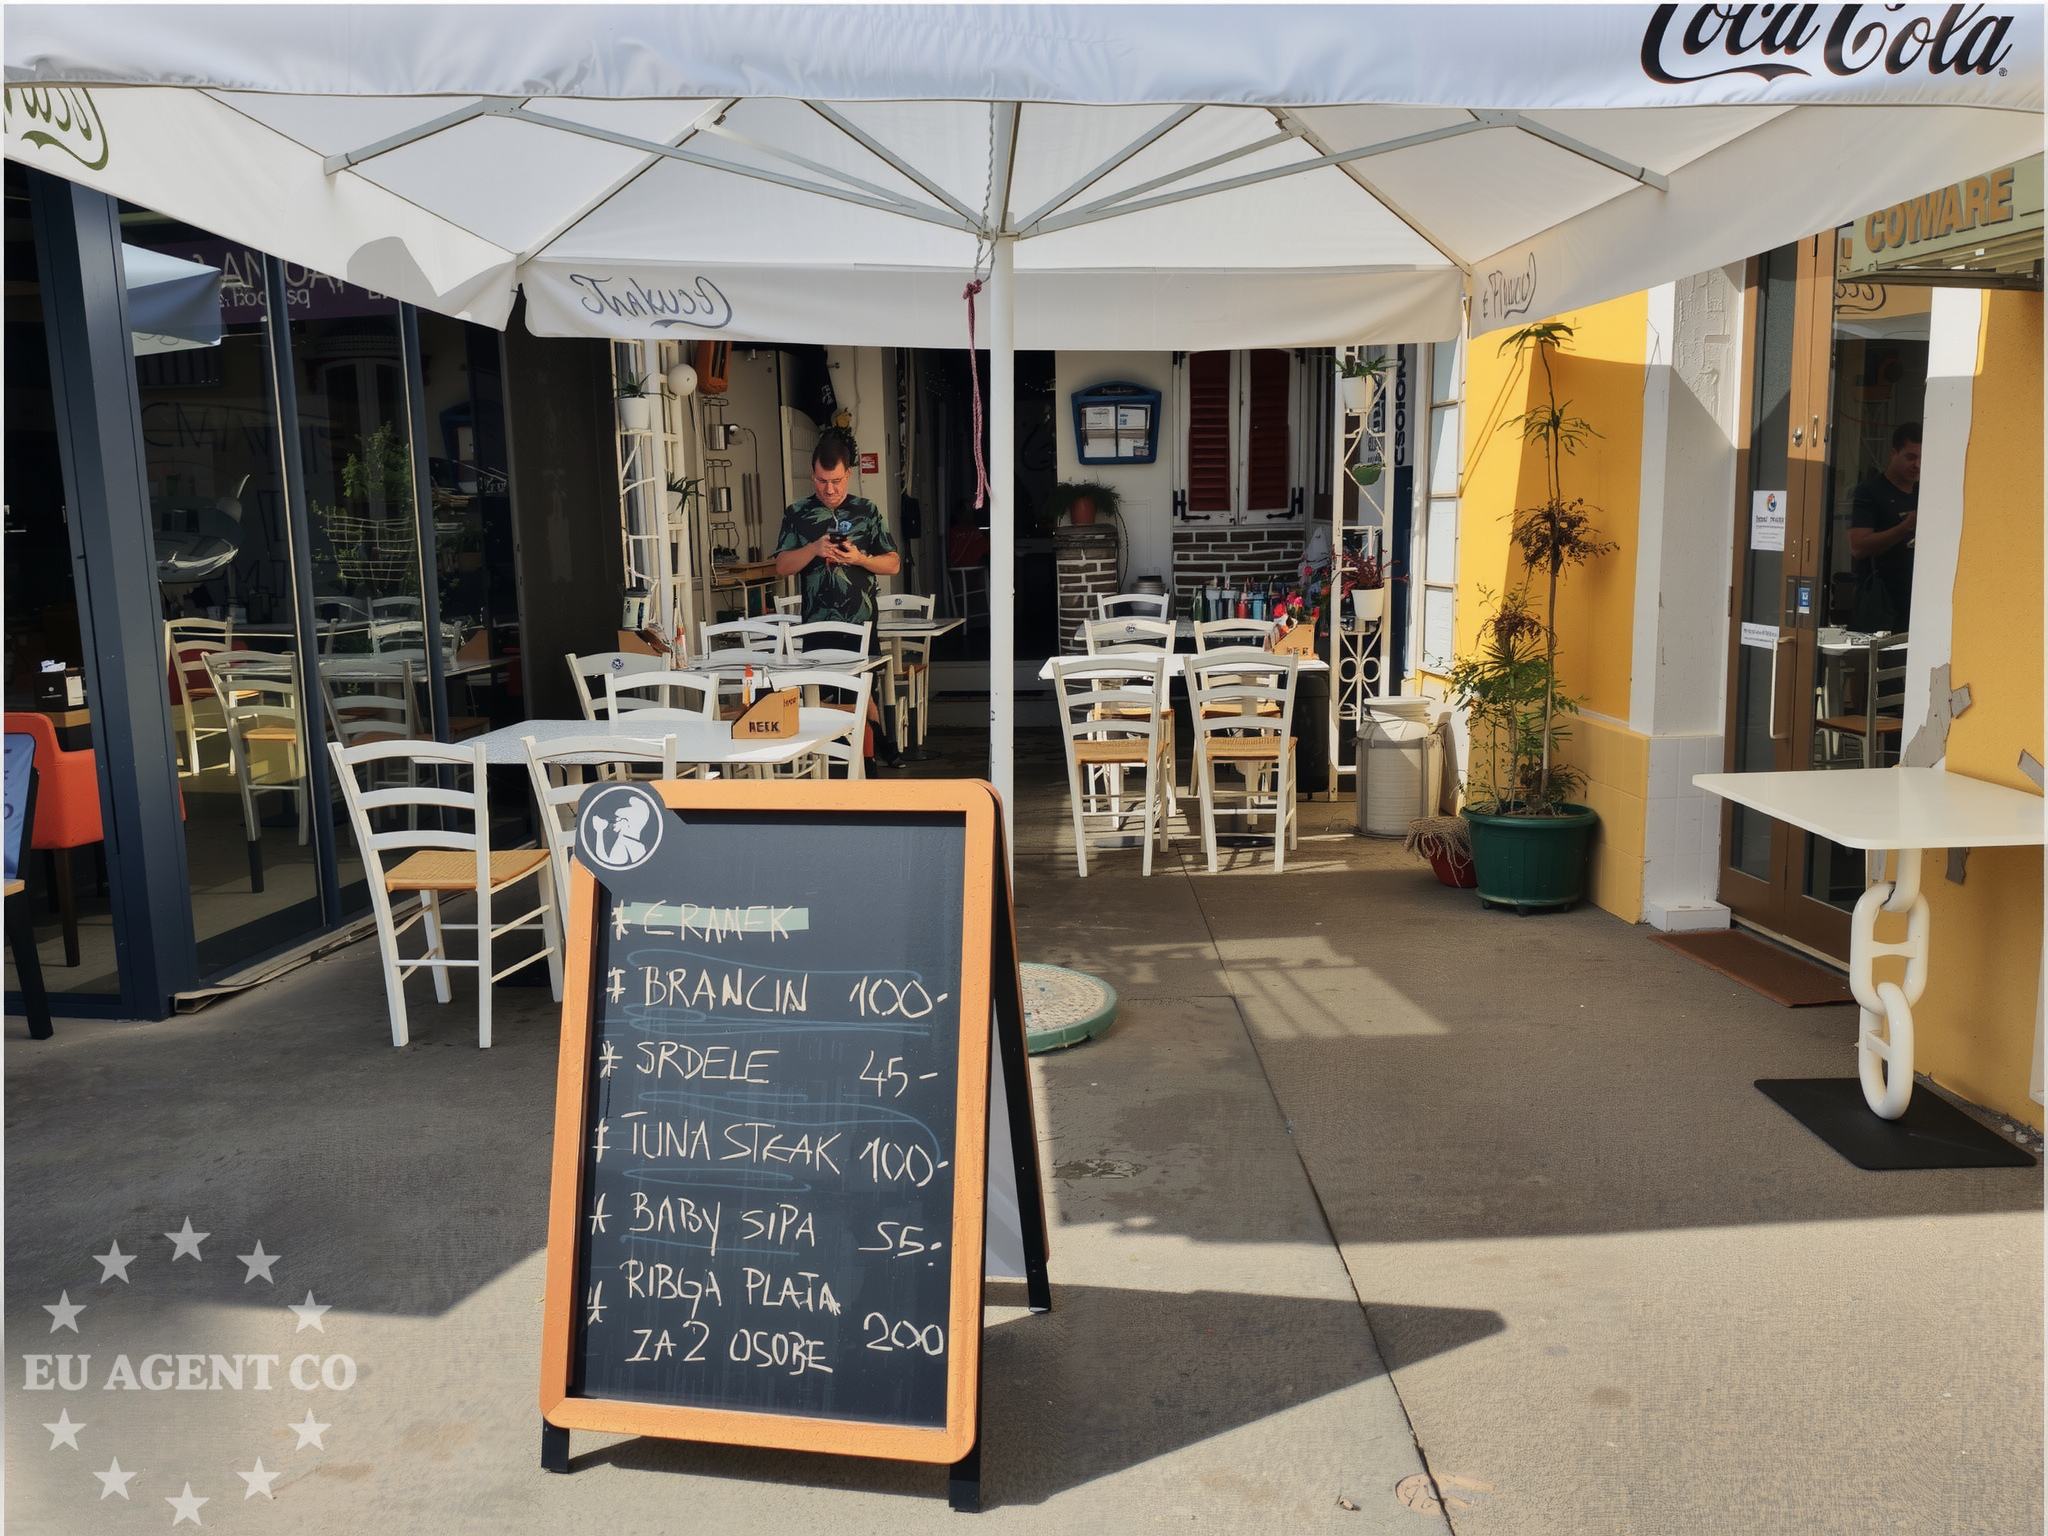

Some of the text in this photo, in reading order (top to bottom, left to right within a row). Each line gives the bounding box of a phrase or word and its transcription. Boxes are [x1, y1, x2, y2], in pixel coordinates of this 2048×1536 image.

[638, 966, 809, 1015] BRANCIN
[636, 1041, 780, 1084] SRDELE
[621, 1111, 710, 1161] TUNA
[718, 1122, 842, 1176] STEAK
[629, 1191, 721, 1257] BABY
[741, 1203, 815, 1247] SIPA
[625, 1329, 677, 1362] ZA
[683, 1320, 709, 1362] 2
[863, 1311, 944, 1355] 200
